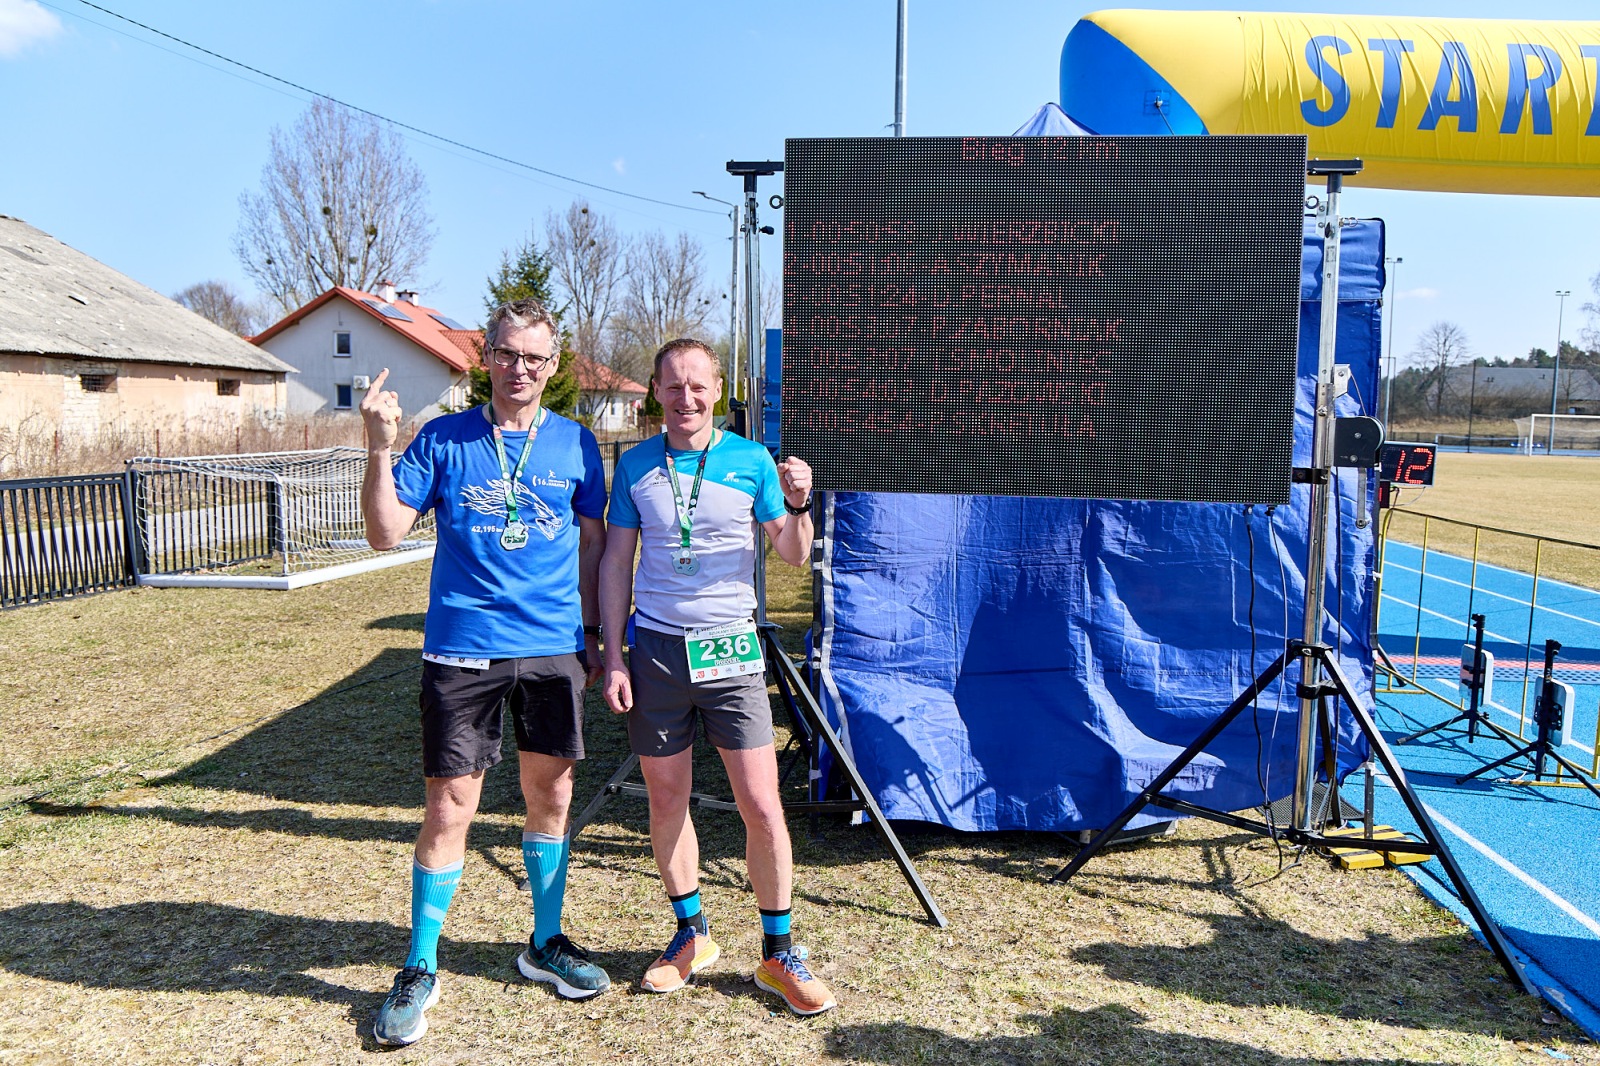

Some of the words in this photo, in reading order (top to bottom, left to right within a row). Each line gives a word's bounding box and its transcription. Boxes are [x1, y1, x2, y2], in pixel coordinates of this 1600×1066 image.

[961, 137, 1025, 166] Bieg
[1037, 137, 1068, 160] 12
[1078, 137, 1120, 160] km
[1394, 447, 1433, 485] 12
[699, 634, 752, 661] 236
